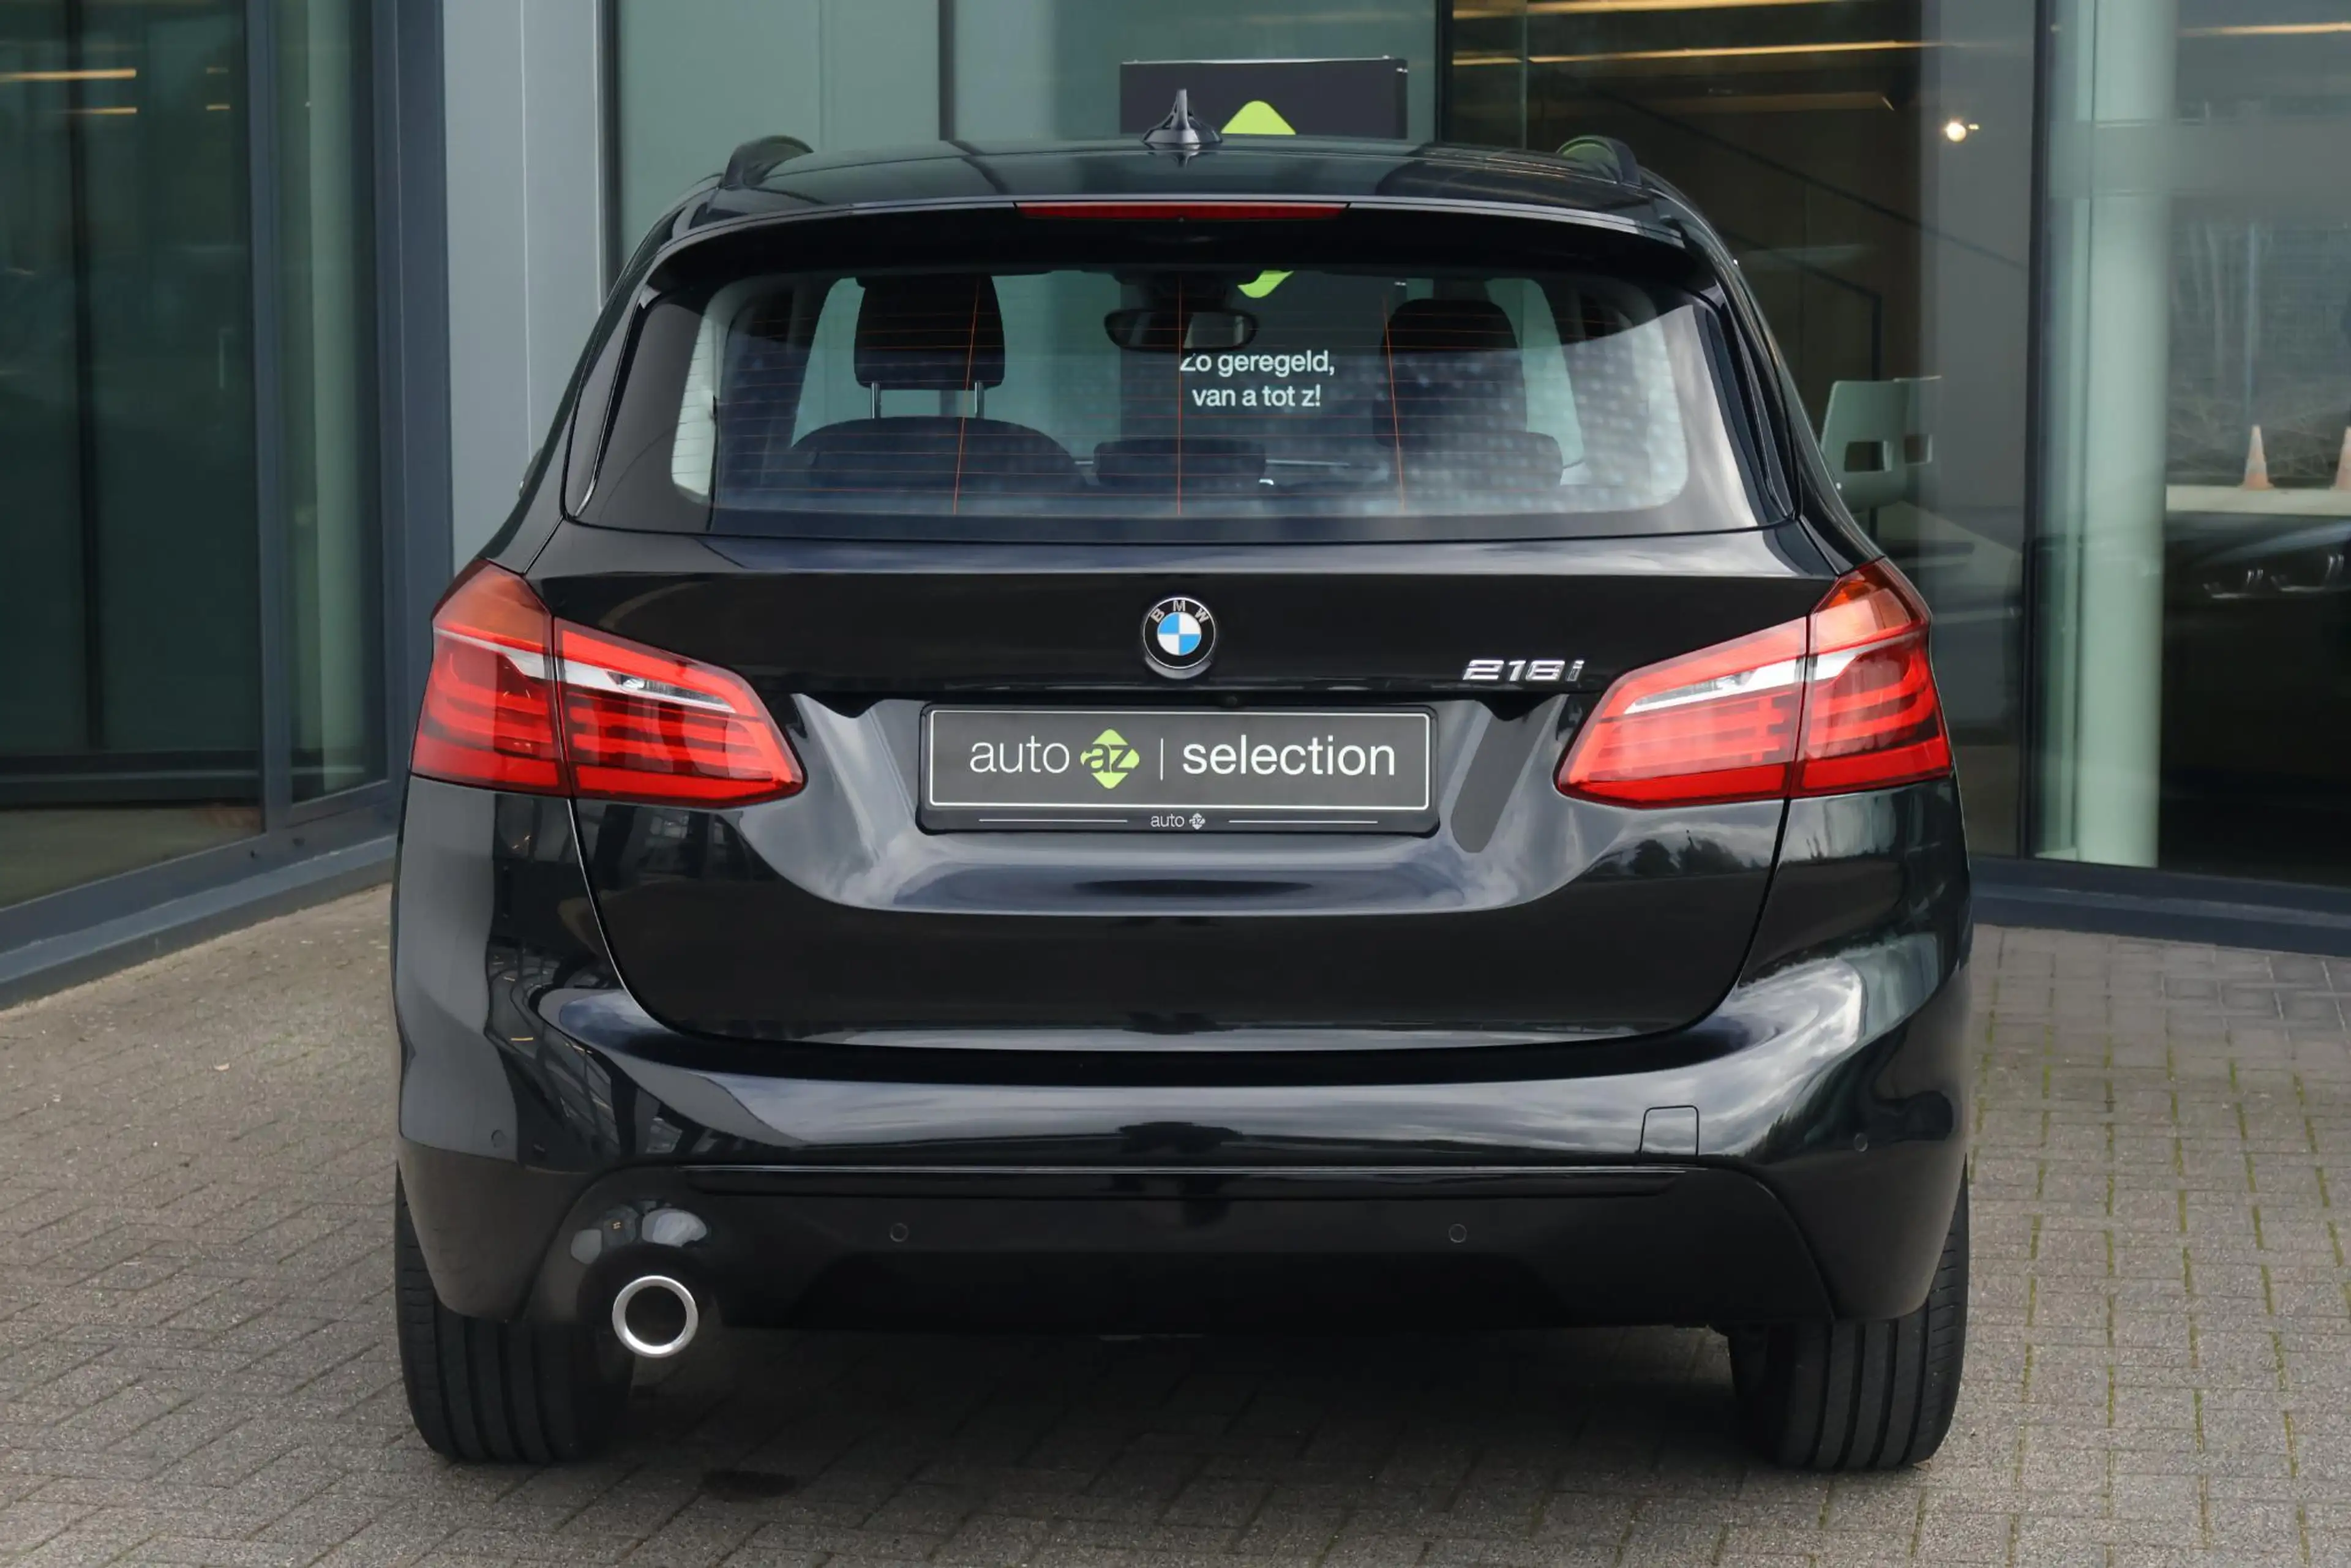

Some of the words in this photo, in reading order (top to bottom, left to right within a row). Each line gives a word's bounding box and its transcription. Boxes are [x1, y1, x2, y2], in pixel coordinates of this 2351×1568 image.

[1218, 350, 1335, 378] geregeld,
[1191, 389, 1236, 407] van
[1242, 389, 1258, 407] a
[1261, 385, 1296, 407] tot
[1301, 384, 1321, 407] z!
[1150, 600, 1210, 624] BMW
[969, 735, 1070, 774] auto
[1182, 734, 1395, 776] selection
[1150, 812, 1185, 828] auto
